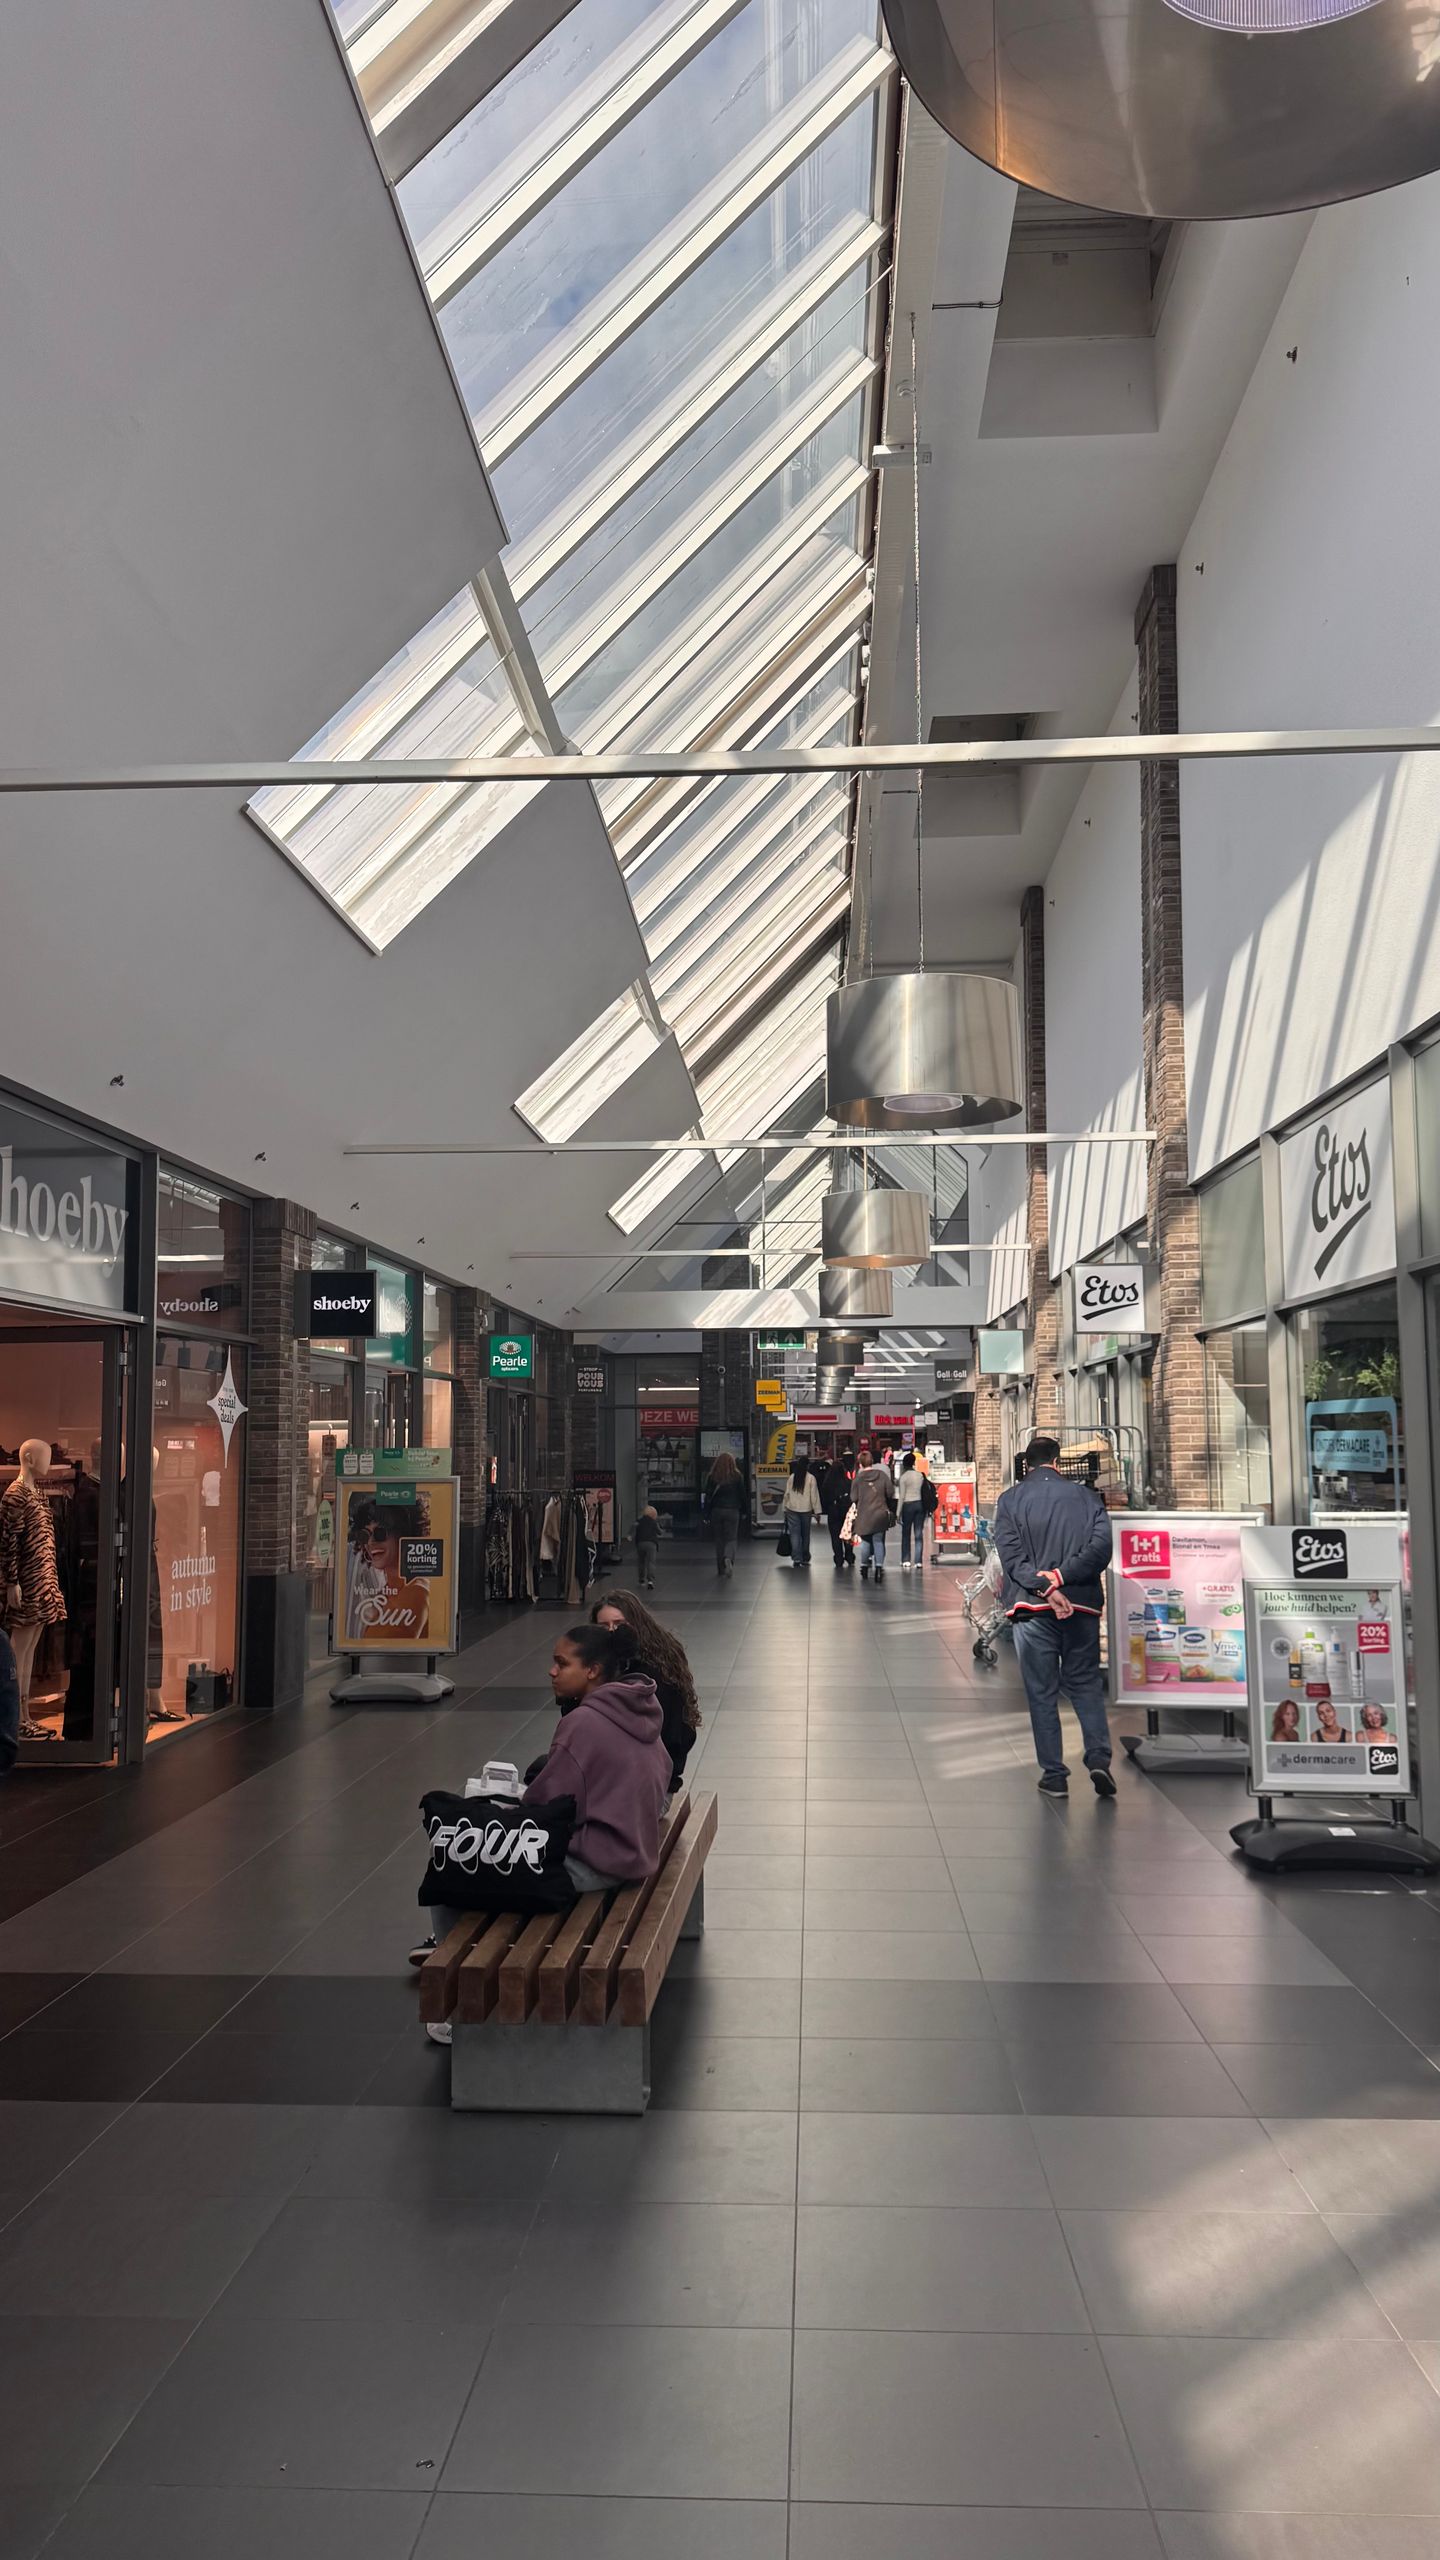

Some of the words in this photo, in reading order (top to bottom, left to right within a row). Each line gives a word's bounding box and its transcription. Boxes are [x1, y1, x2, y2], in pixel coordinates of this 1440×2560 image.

[1312, 1125, 1372, 1233] Etos
[1081, 1275, 1140, 1307] Etos
[313, 1295, 372, 1313] shoeby
[492, 1355, 528, 1367] Pearle
[577, 1372, 604, 1380] POUR
[953, 1370, 967, 1378] Gall
[577, 1380, 604, 1388] VOUS
[217, 1395, 236, 1410] special
[220, 1409, 235, 1424] deals
[757, 1466, 788, 1474] ZEEMAN
[407, 1543, 437, 1555] 20%
[1130, 1534, 1161, 1552] 1+1
[1295, 1535, 1345, 1562] Etos
[407, 1554, 437, 1565] korting
[1131, 1552, 1162, 1564] gratis
[171, 1553, 216, 1580] autumn
[170, 1585, 182, 1612] in
[186, 1577, 212, 1613] style
[353, 1586, 380, 1596] Wear
[382, 1586, 398, 1596] the
[1264, 1592, 1285, 1601] Hoe
[1288, 1592, 1328, 1601] kunnen
[1329, 1594, 1344, 1602] we
[355, 1595, 417, 1626] Sun
[1264, 1603, 1289, 1614] jouw
[1291, 1603, 1315, 1613] huid
[1316, 1603, 1357, 1615] helpen?
[1360, 1625, 1387, 1638] 20%
[1292, 1753, 1357, 1765] dermacare
[1370, 1748, 1397, 1765] Etos
[429, 1818, 550, 1872] FOUR
